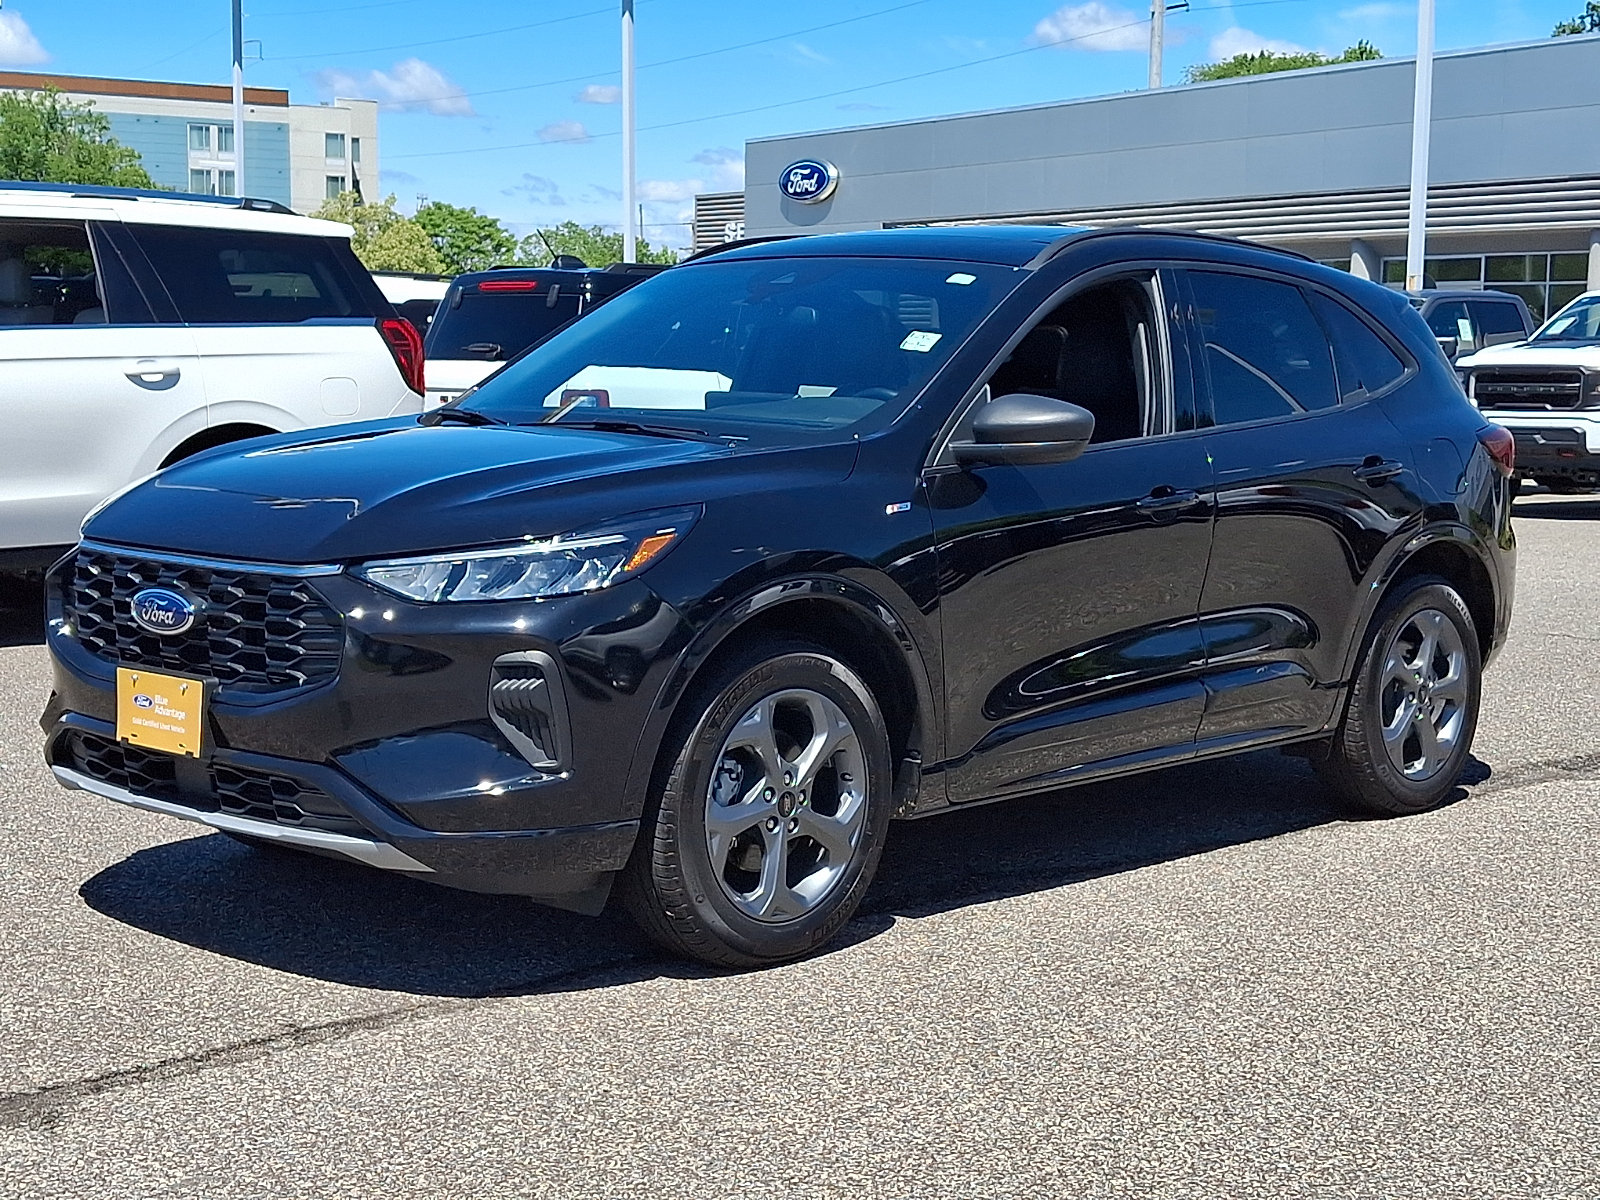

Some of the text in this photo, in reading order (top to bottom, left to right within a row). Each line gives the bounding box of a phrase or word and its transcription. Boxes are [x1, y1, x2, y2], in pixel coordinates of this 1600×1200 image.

[787, 168, 820, 194] Ford
[141, 597, 177, 625] Ford
[136, 695, 151, 707] Ford
[154, 694, 168, 706] Blue
[154, 705, 187, 721] Advantage
